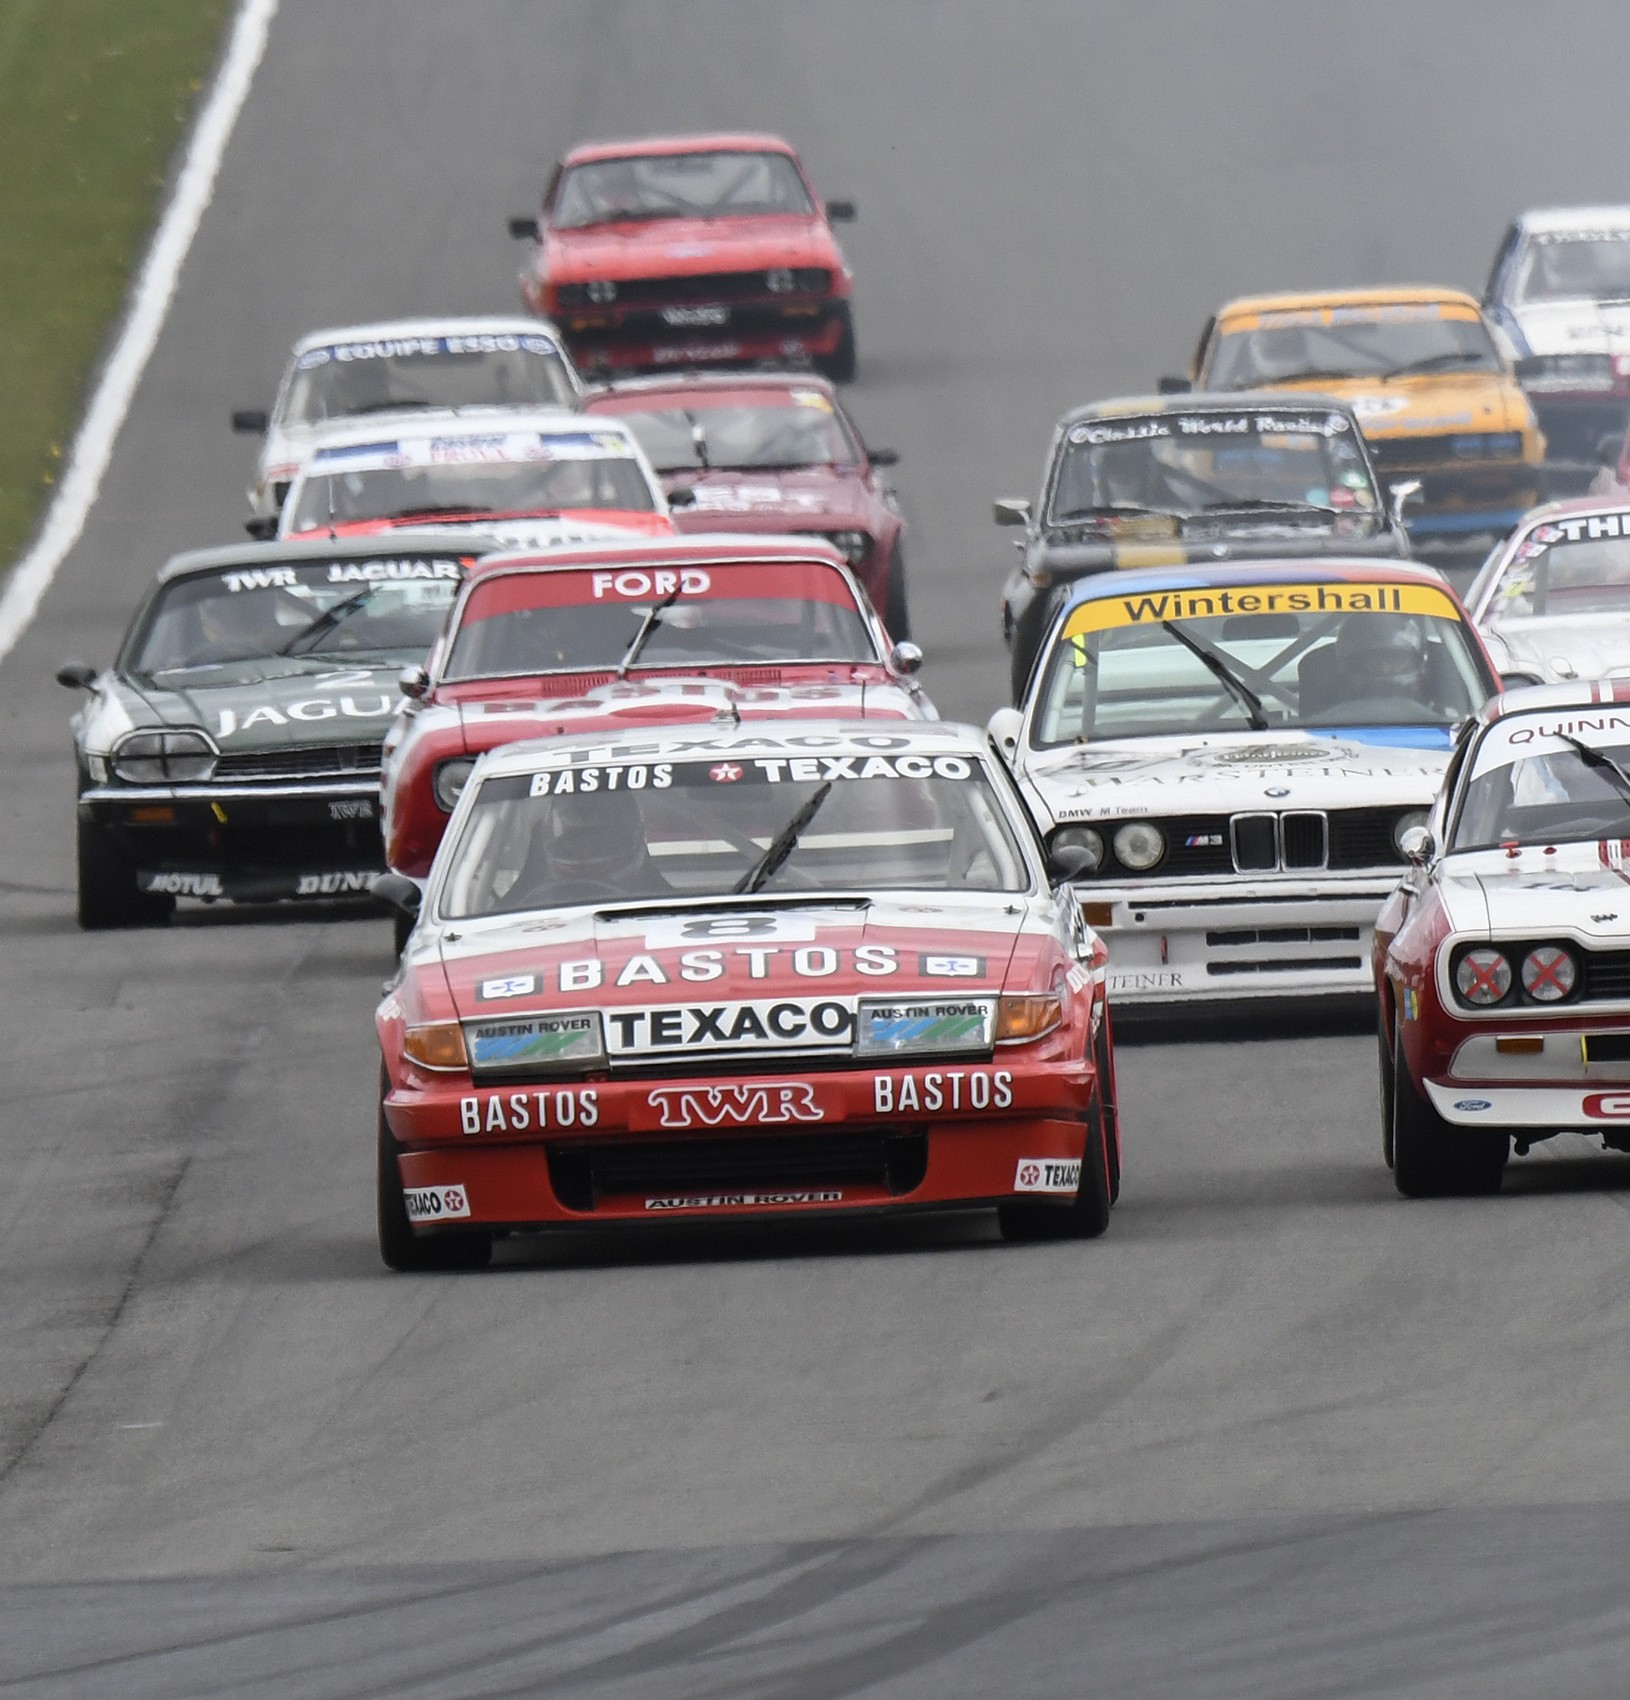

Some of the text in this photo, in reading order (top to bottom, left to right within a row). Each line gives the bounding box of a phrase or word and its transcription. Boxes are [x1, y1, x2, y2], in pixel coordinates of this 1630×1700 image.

[220, 559, 461, 592] TWR JAGUAR
[592, 570, 711, 598] FORD
[1123, 588, 1401, 622] Wintershall
[553, 735, 911, 763] TEXACO
[529, 756, 972, 798] BASTOS TEXACO
[558, 945, 899, 992] BASTOS
[609, 1001, 853, 1049] TEXACO
[870, 1005, 989, 1019] AUSTIN ROVER
[475, 1019, 591, 1039] AUSTIN ROVER
[647, 1083, 825, 1127] TWR
[873, 1071, 1014, 1114] BASTOS
[1460, 1101, 1486, 1110] Ford
[460, 1090, 600, 1135] BASTOS
[1044, 1163, 1081, 1187] TEXACO
[648, 1191, 842, 1209] AUSTIN ROVER
